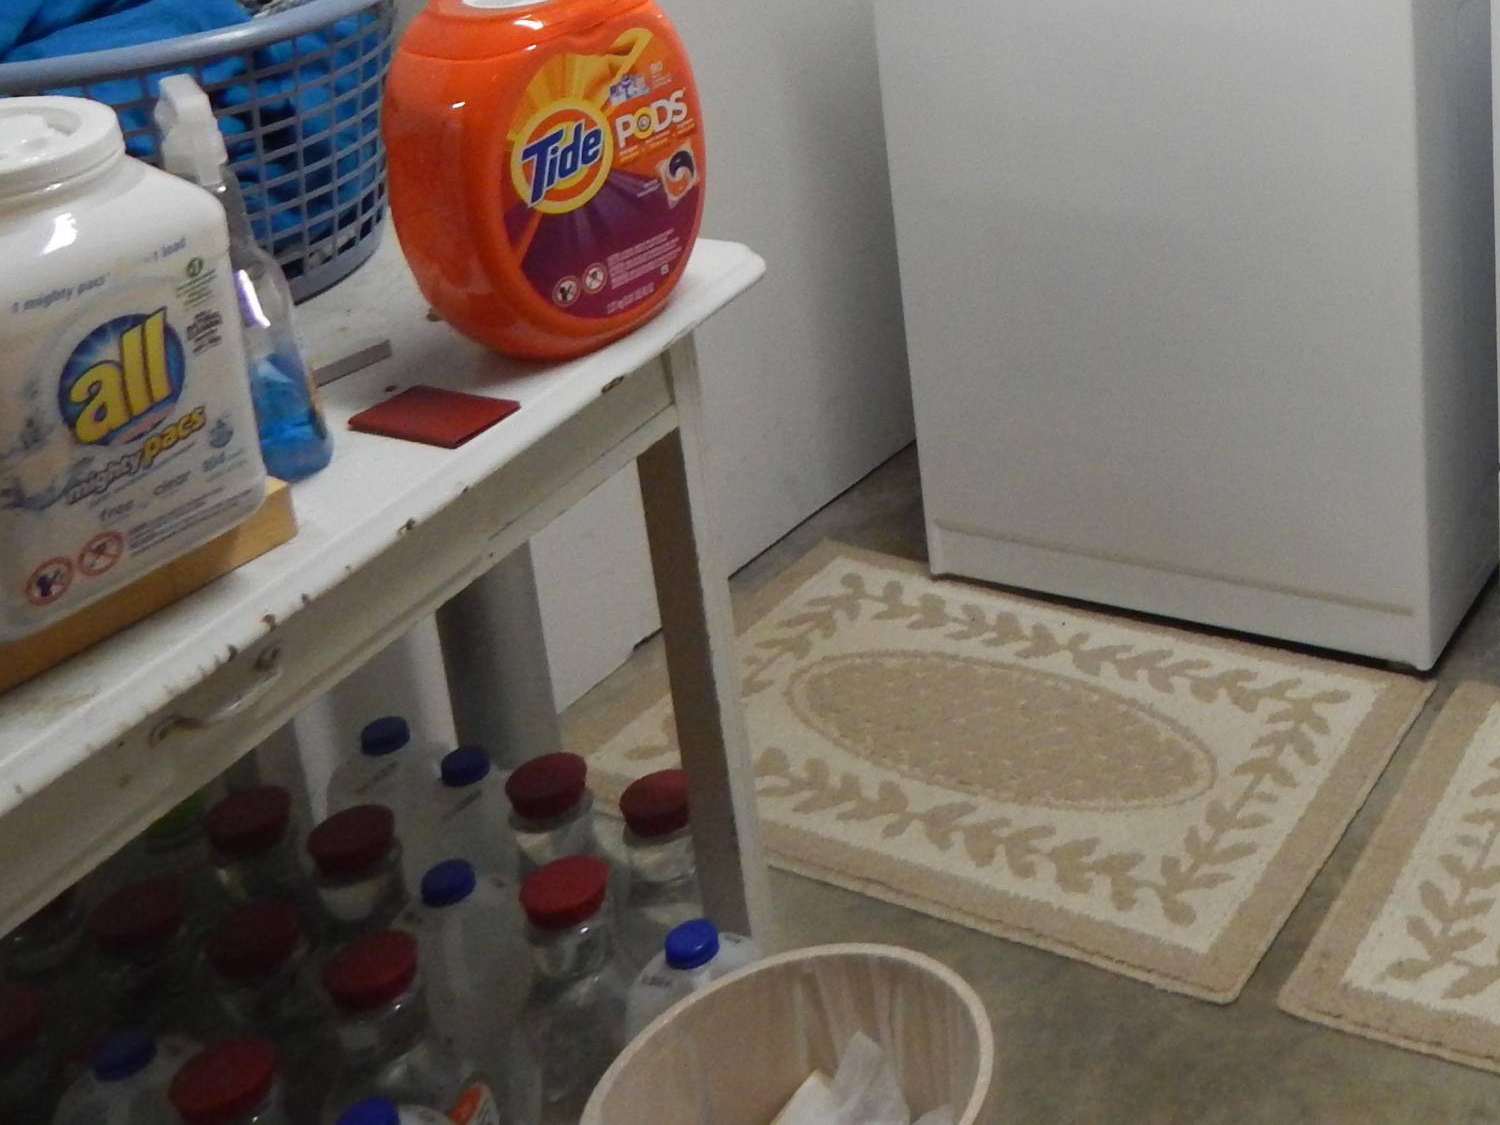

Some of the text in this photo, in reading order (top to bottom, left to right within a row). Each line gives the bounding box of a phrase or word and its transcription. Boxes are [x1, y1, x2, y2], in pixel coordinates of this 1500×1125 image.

[521, 118, 604, 208] Tide
[615, 89, 688, 148] PODS
[68, 306, 172, 445] all
[66, 449, 143, 505] mighty
[140, 406, 206, 468] pacs
